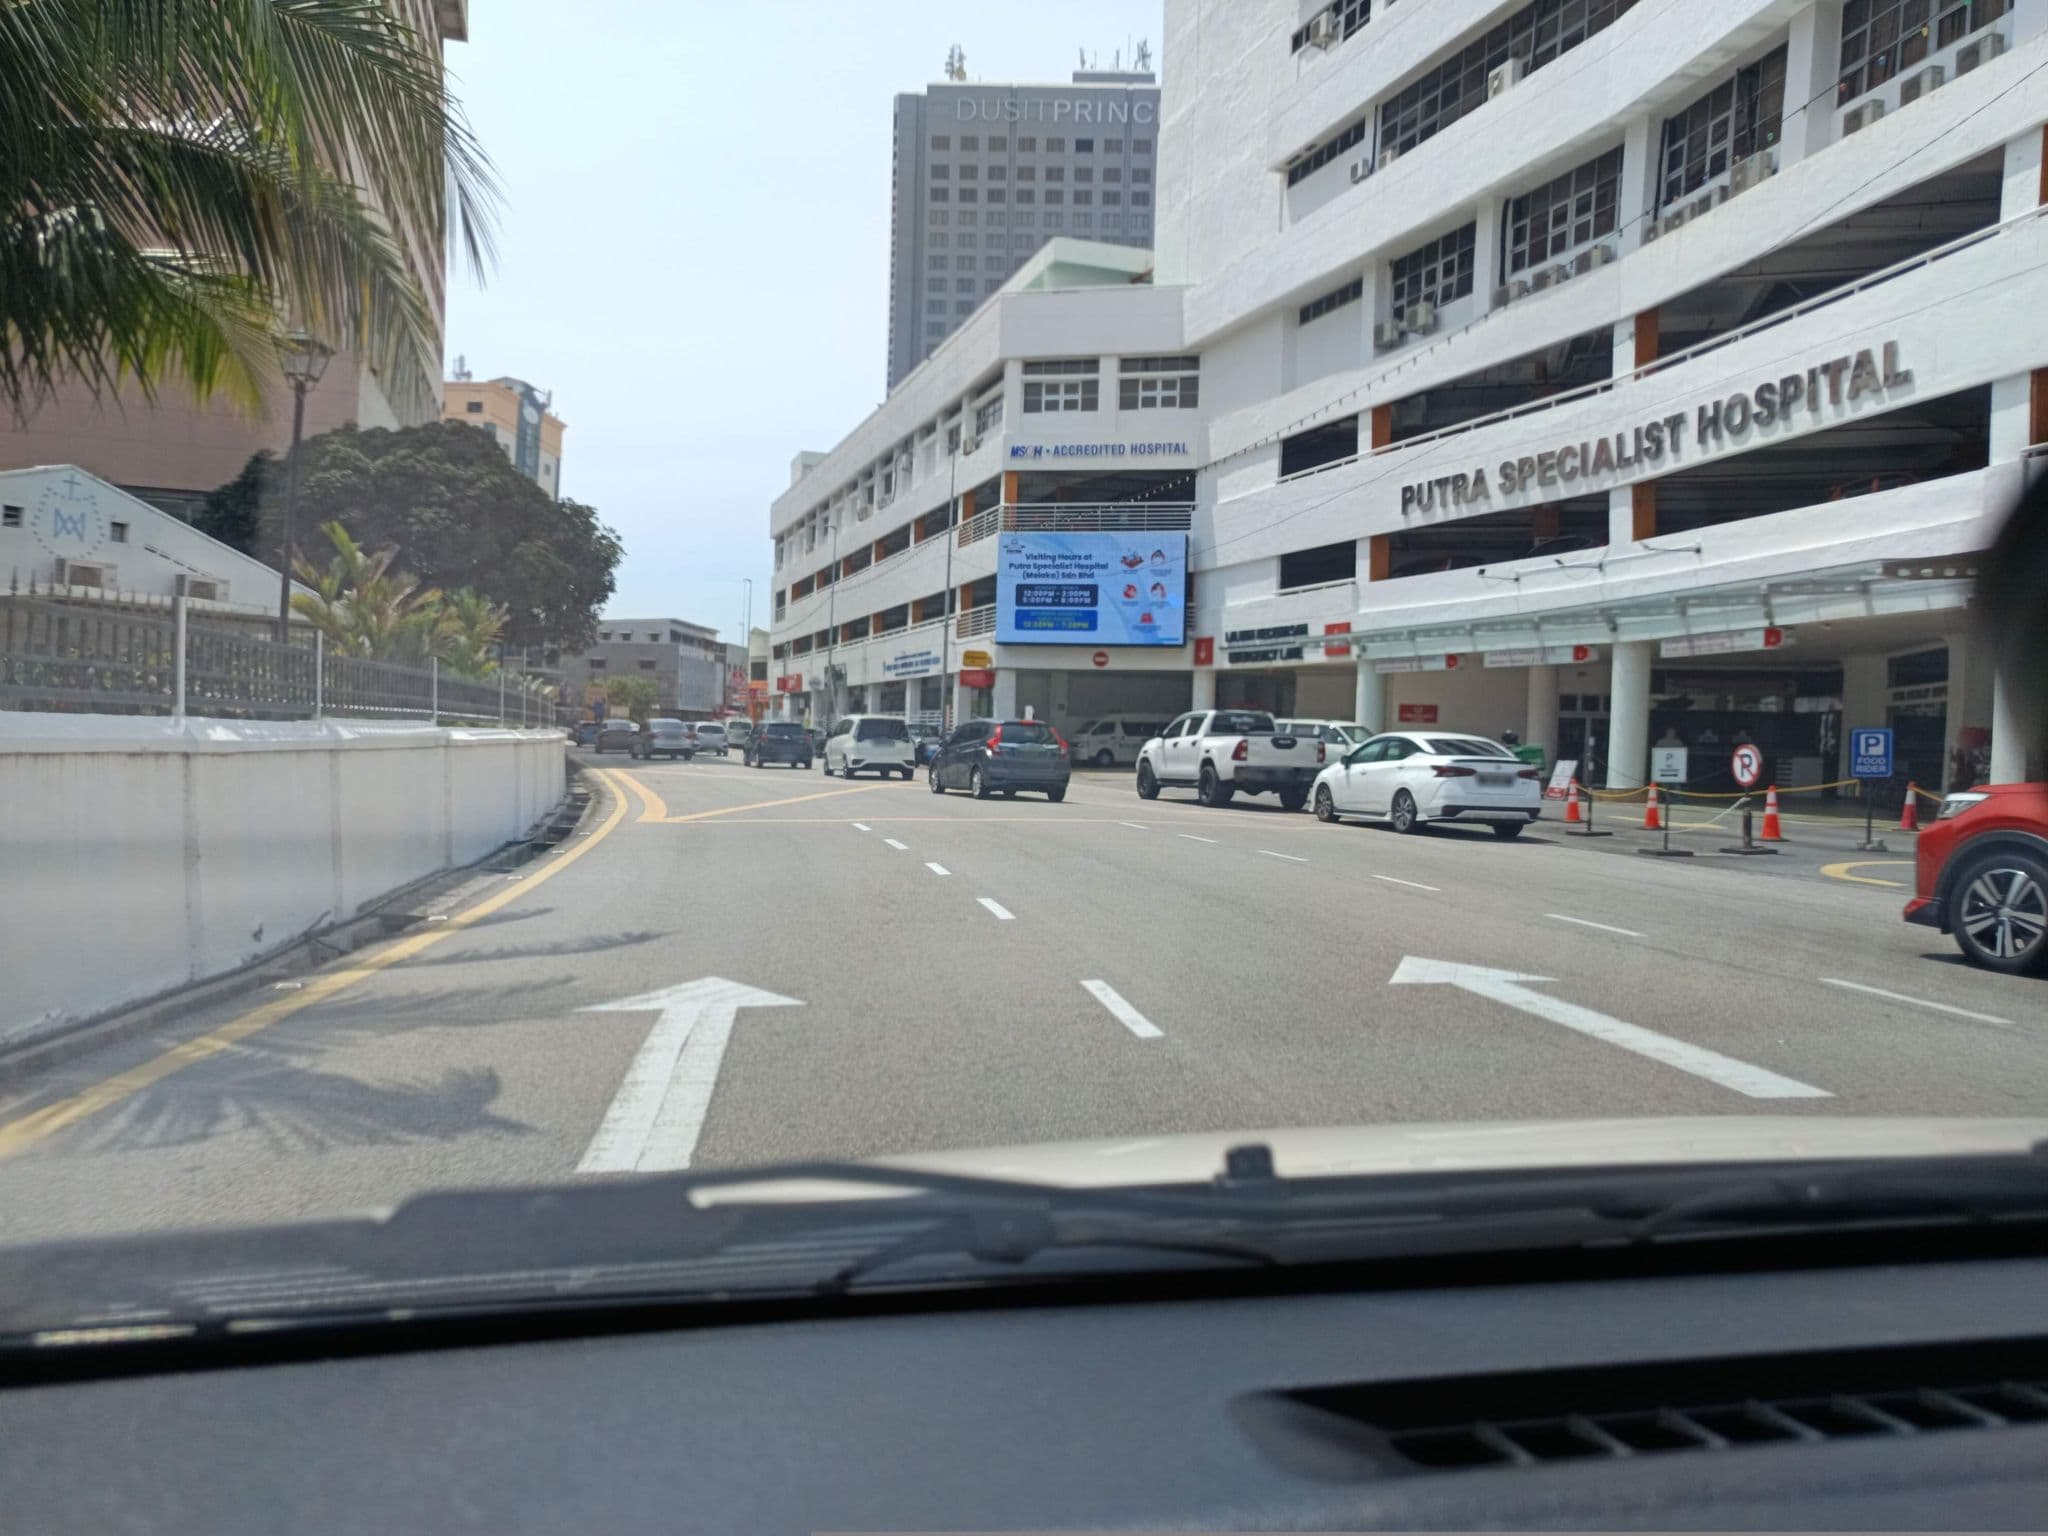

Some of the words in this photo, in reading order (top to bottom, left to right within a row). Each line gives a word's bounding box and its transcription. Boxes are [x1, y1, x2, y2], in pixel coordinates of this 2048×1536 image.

[1401, 467, 1490, 516] PUTRA
[1498, 410, 1688, 496] SPECIALIST
[1697, 339, 1914, 446] HOSPITAL
[1052, 443, 1126, 457] ACCREDITED
[1130, 442, 1189, 456] HOSPITAL
[1025, 552, 1057, 564] Visiting
[1058, 552, 1081, 561] Hours
[1082, 553, 1093, 561] at
[1008, 562, 1032, 570] Putra
[1032, 562, 1073, 572] Specialist
[1074, 562, 1109, 572] Hospital
[1864, 736, 1881, 755] P
[1857, 756, 1887, 766] FOOD
[1855, 765, 1888, 773] RIDER
